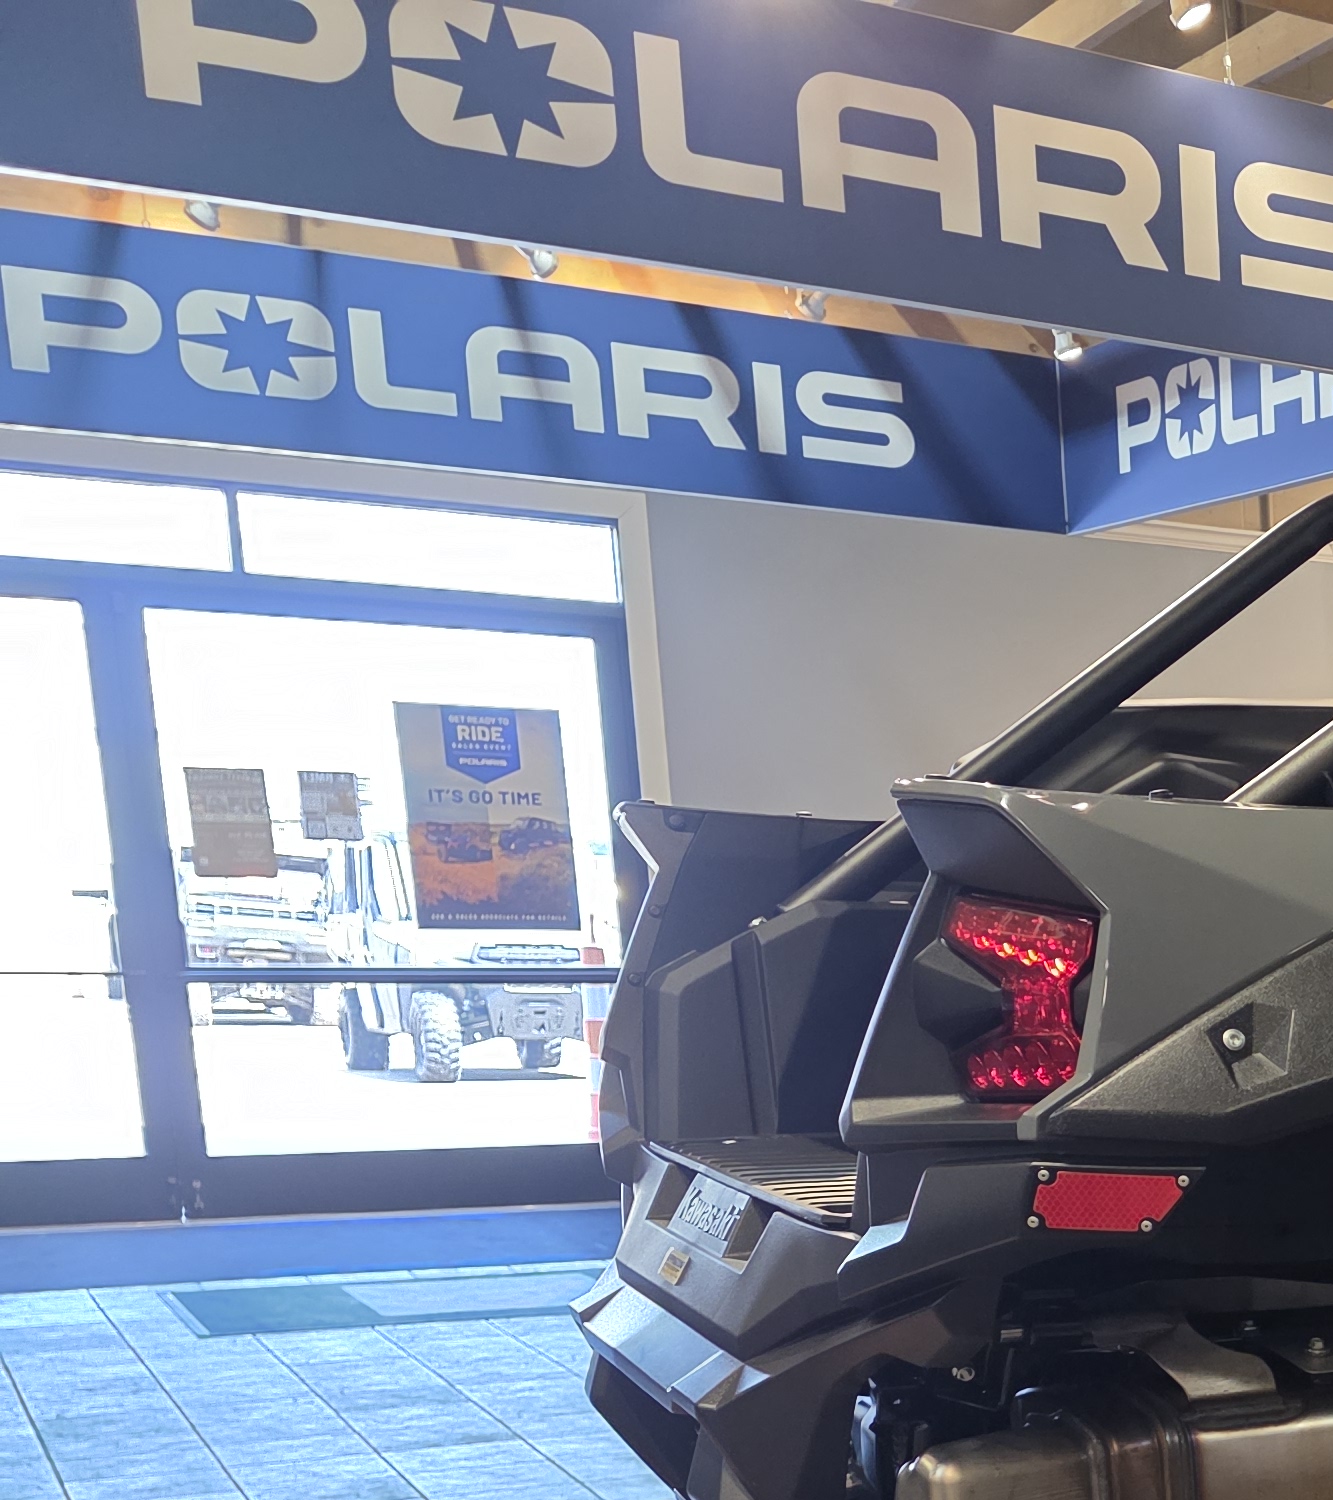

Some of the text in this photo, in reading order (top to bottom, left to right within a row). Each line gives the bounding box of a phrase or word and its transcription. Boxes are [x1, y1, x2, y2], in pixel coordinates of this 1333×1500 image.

[1, 265, 915, 469] POLARIS
[456, 724, 504, 743] RIDE
[428, 788, 543, 806] IT'S GO TIME
[678, 1186, 741, 1241] Kawasaki
